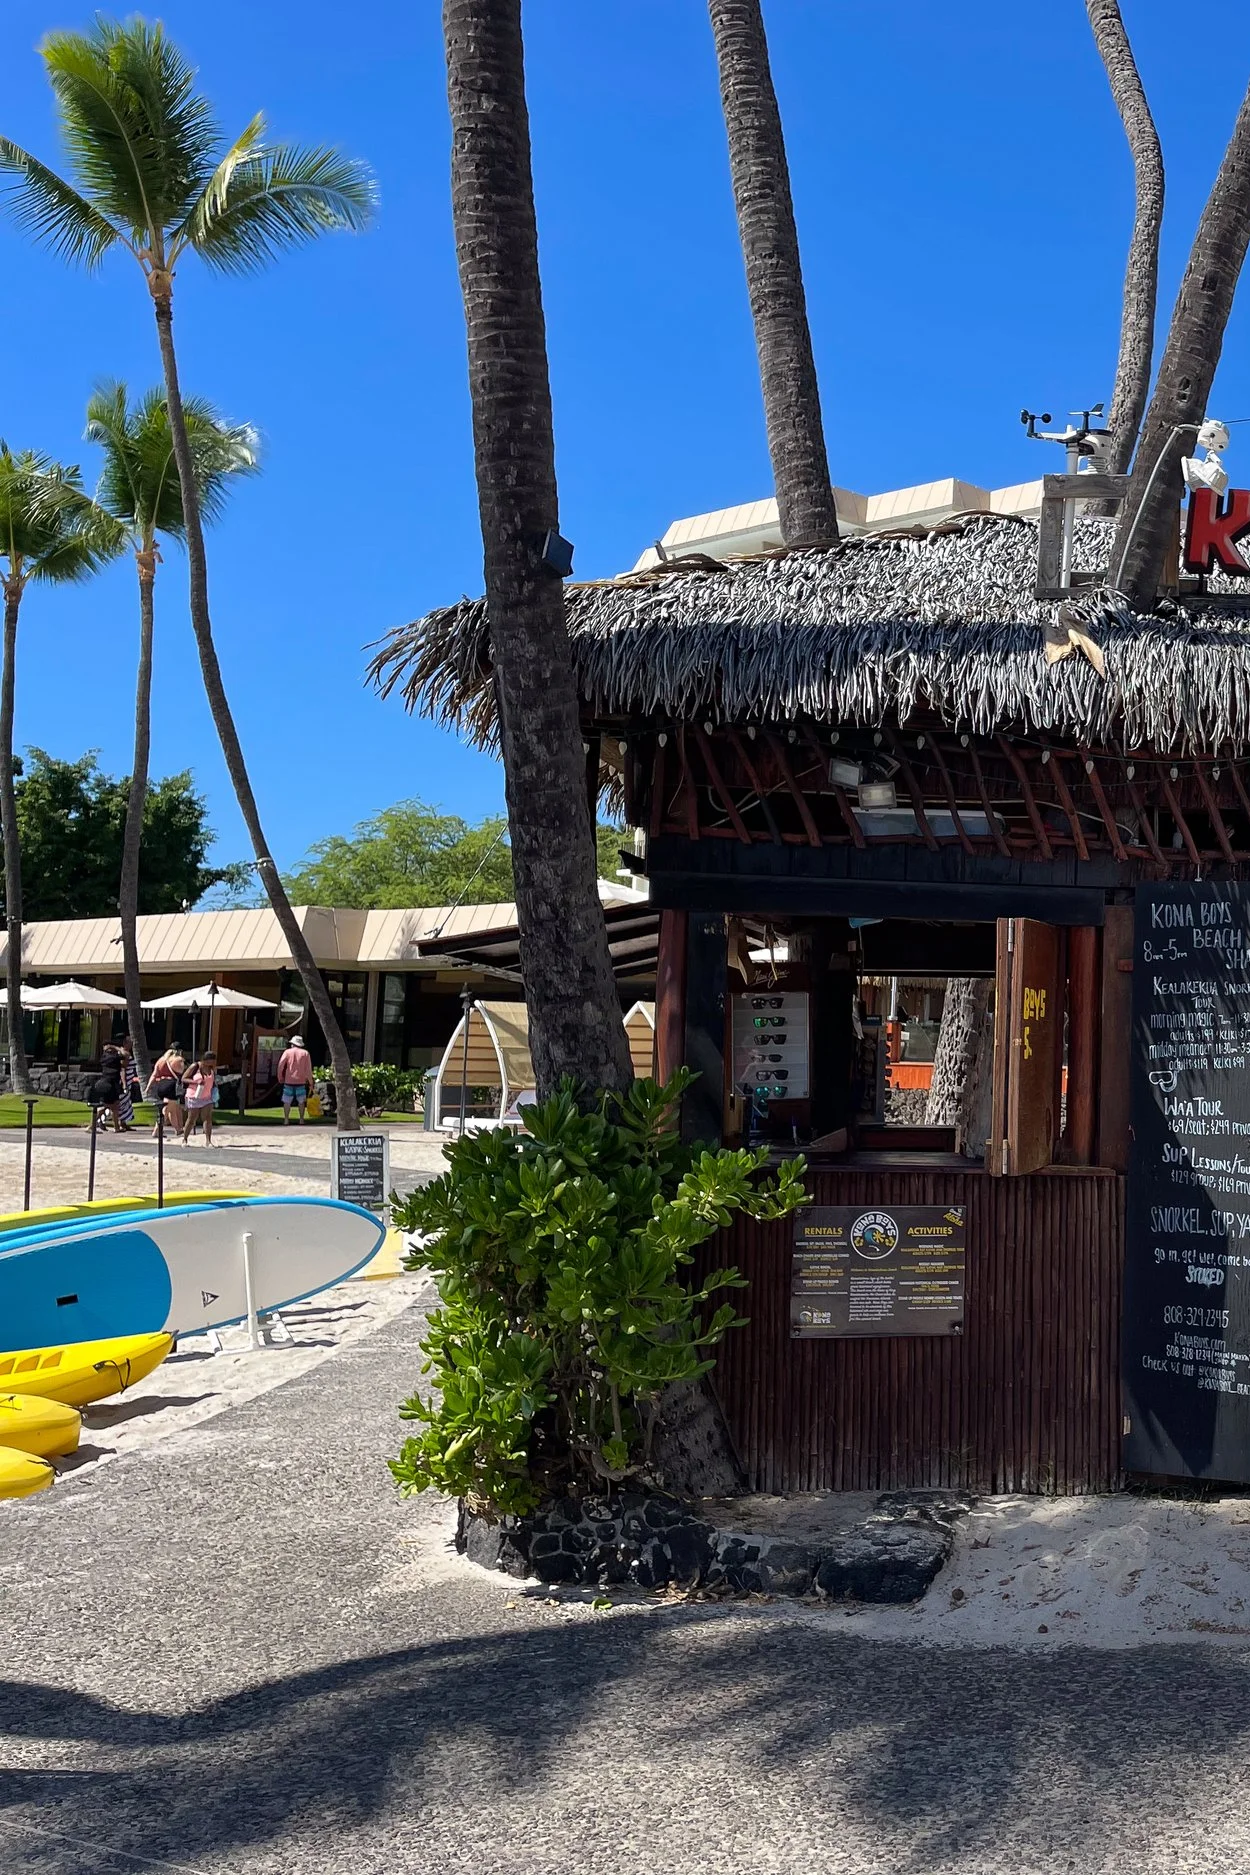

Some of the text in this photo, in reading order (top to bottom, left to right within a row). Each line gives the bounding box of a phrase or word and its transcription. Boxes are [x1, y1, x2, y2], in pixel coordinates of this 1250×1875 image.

[1151, 902, 1232, 928] KONA BOYS
[1193, 928, 1241, 949] BEACH
[1023, 987, 1046, 1020] BOYS
[1191, 996, 1216, 1009] TOUR
[1150, 1011, 1185, 1028] morning
[1188, 1009, 1215, 1028] magic
[1170, 1029, 1194, 1041] adults
[1149, 1041, 1177, 1060] midday
[1179, 1040, 1212, 1057] meander
[1193, 1097, 1224, 1116] TOUR
[1211, 1119, 1230, 1136] $249
[1161, 1143, 1188, 1165] SUP
[1171, 1169, 1189, 1185] $129
[1218, 1176, 1235, 1193] $169
[804, 1227, 843, 1235] RENTALS
[876, 1214, 896, 1236] BOYS
[907, 1226, 953, 1235] ACTIVITIES
[1154, 1248, 1166, 1264] go
[1182, 1249, 1197, 1264] get
[1217, 1254, 1241, 1267] come
[1170, 1361, 1180, 1374] us
[1183, 1363, 1194, 1376] out
